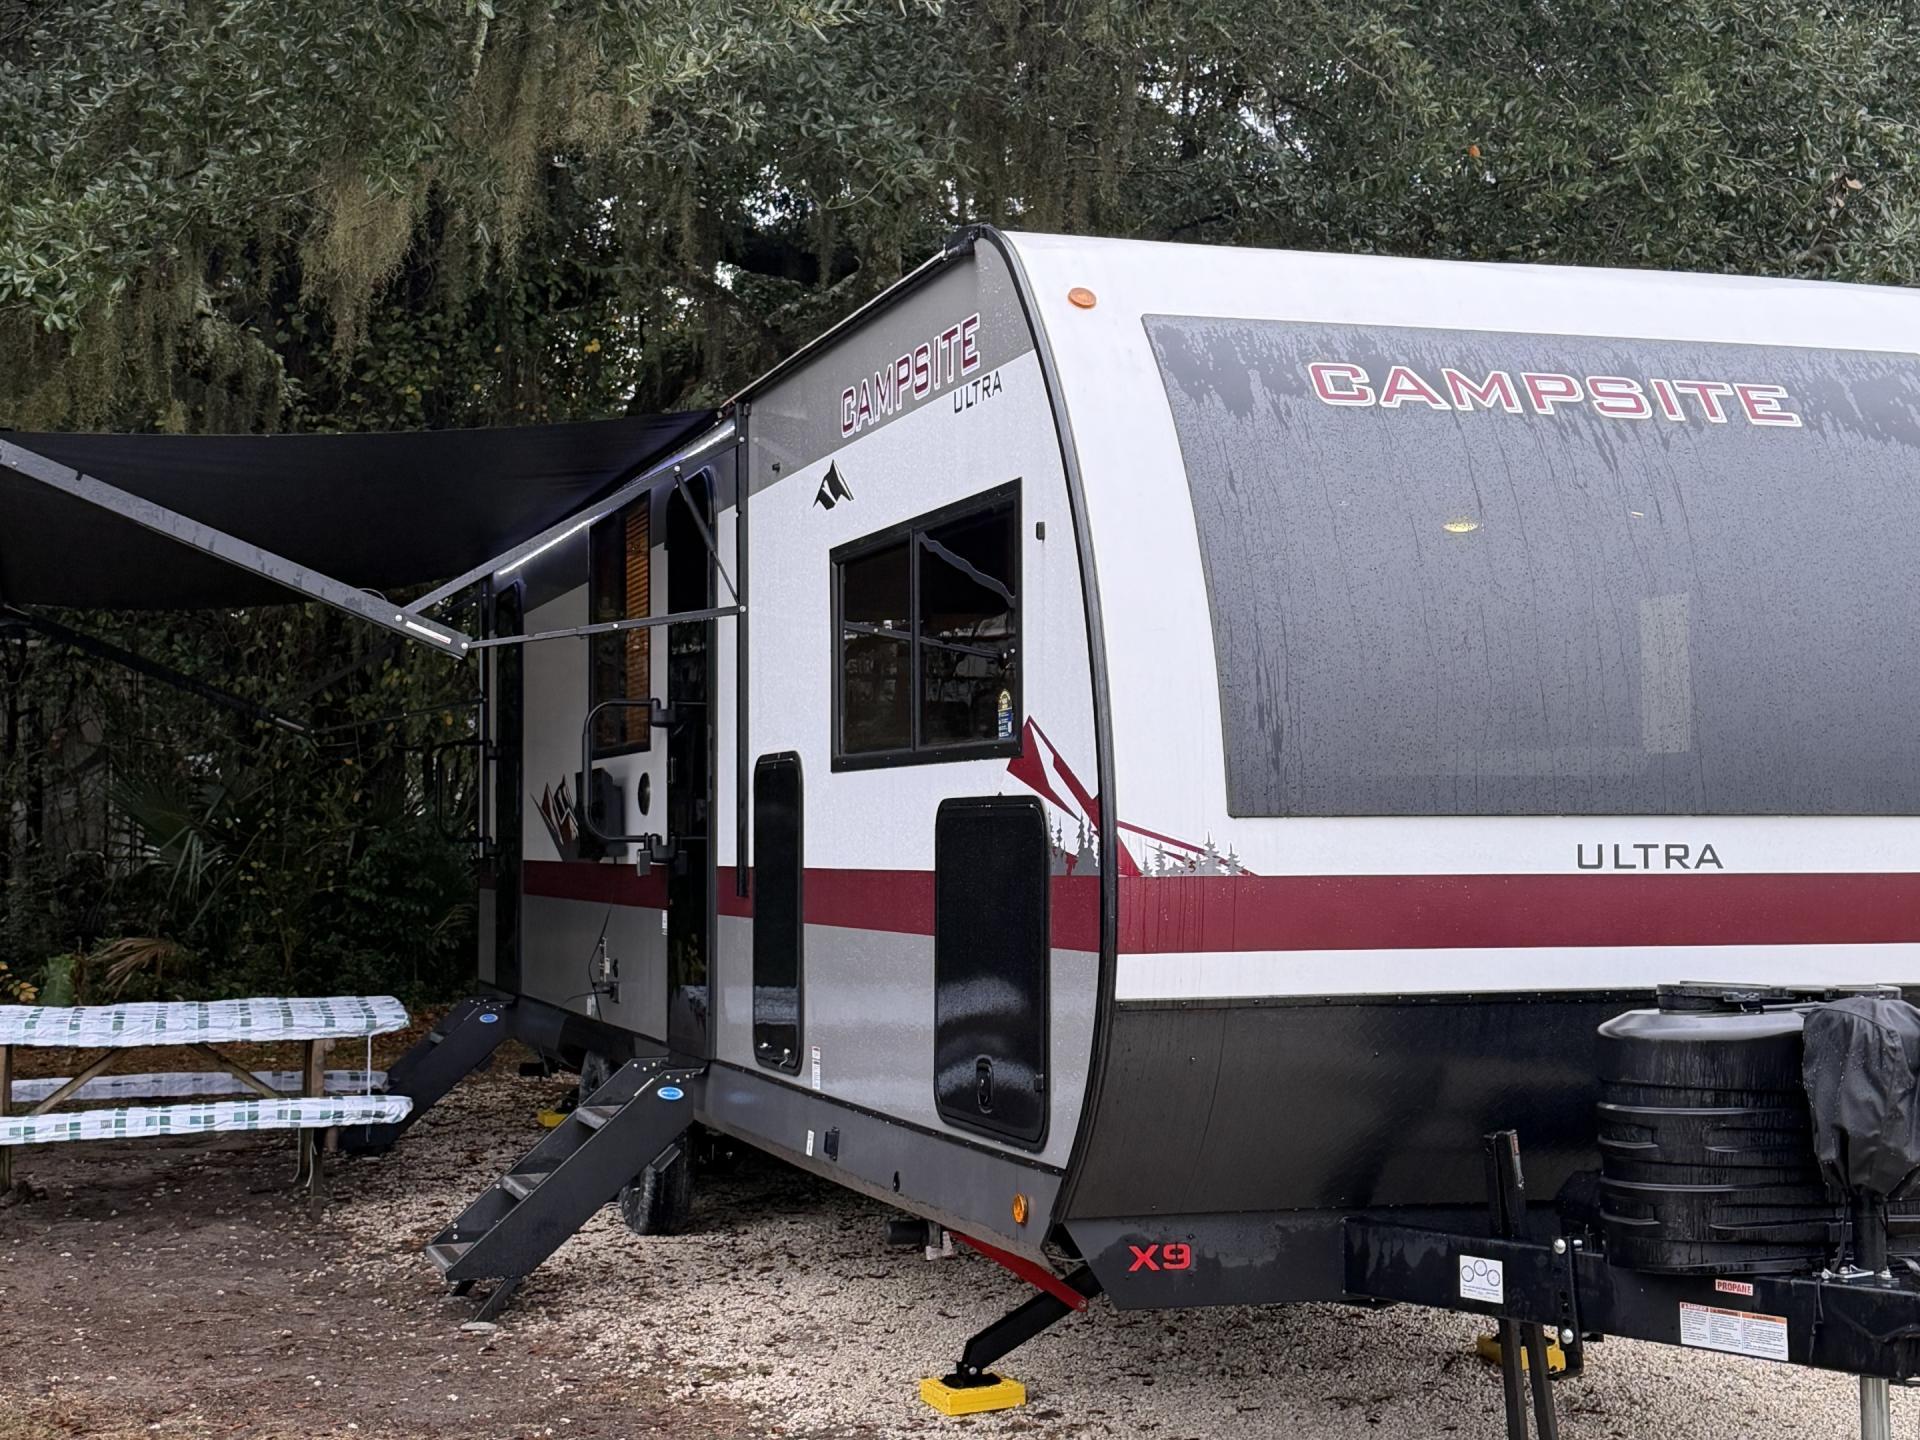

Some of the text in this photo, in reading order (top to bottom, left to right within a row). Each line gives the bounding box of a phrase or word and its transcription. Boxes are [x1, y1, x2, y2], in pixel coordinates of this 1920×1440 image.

[841, 312, 981, 438] CAMPSITE
[954, 371, 1003, 414] ULTRA
[1307, 361, 1803, 428] CAMPSITE
[1577, 843, 1724, 869] ULTRA
[1128, 1243, 1191, 1272] X9
[1717, 1281, 1752, 1294] PROPANE
